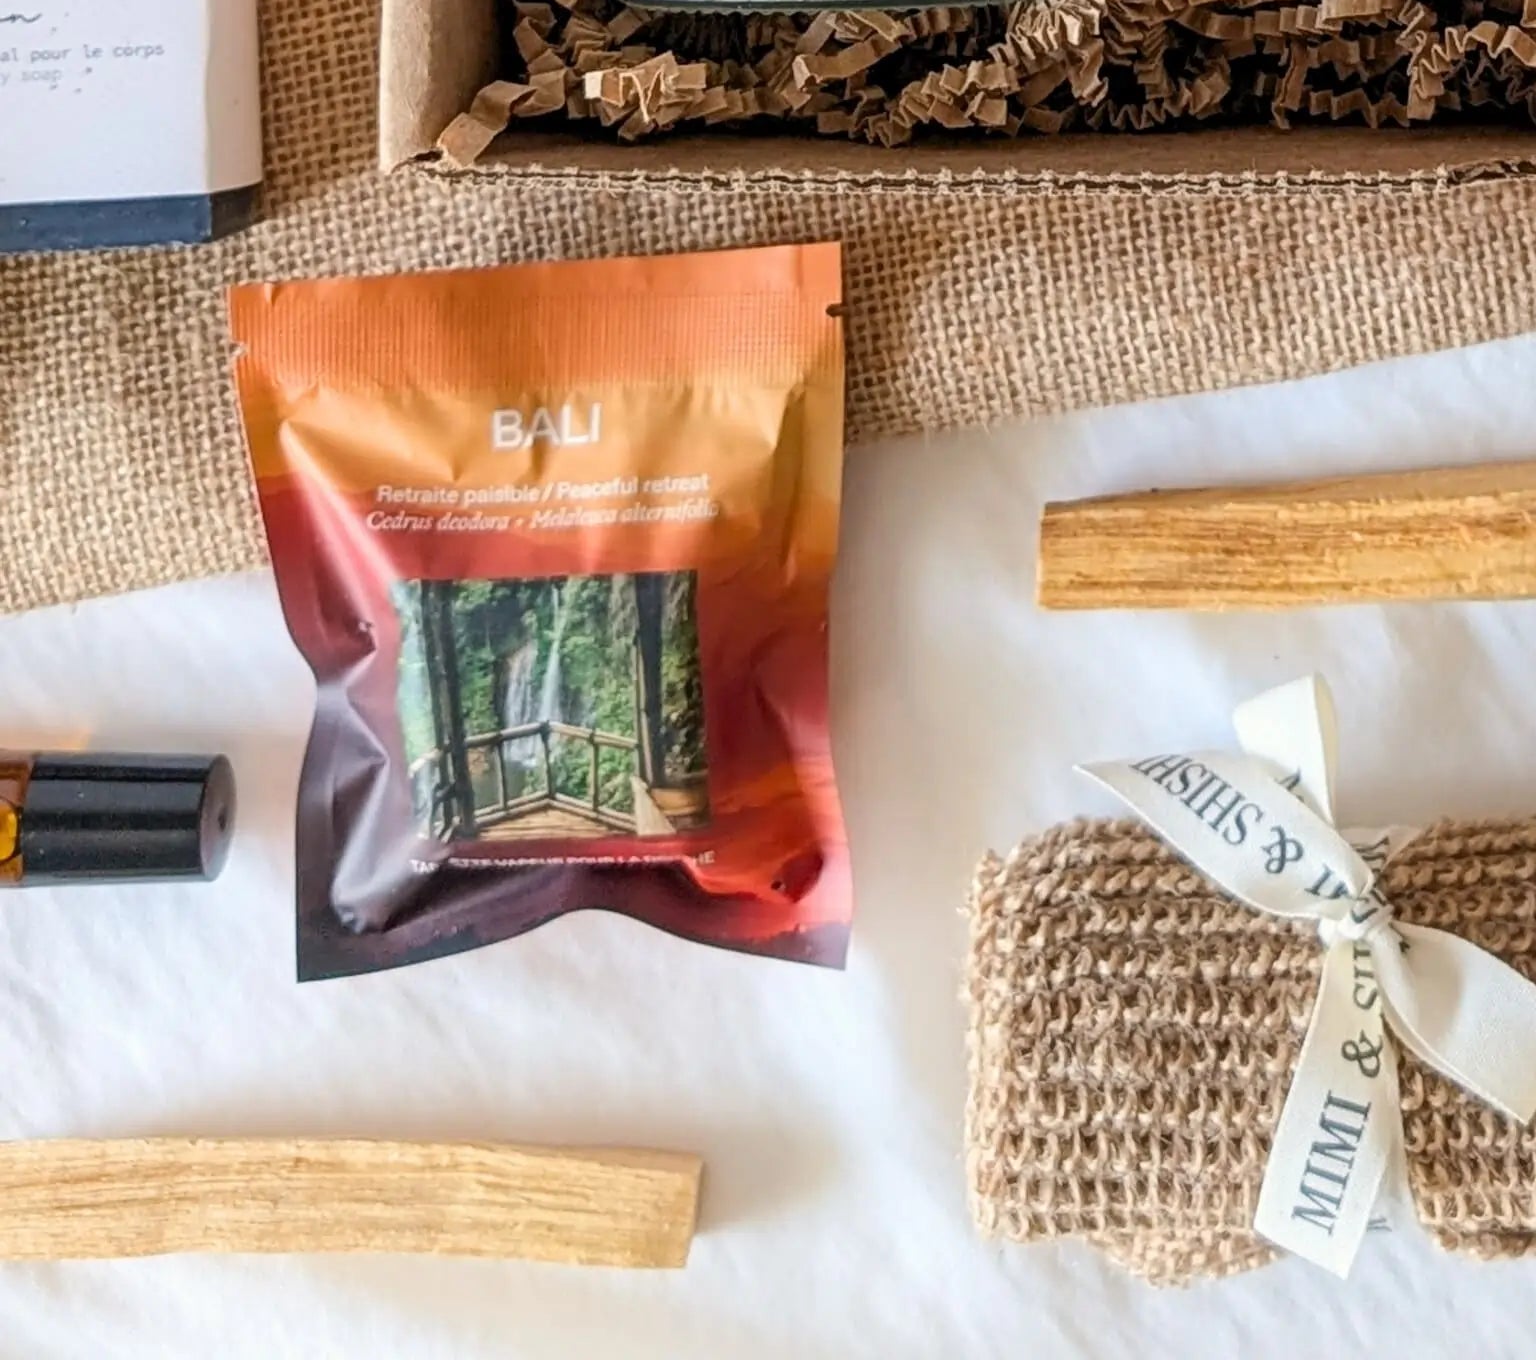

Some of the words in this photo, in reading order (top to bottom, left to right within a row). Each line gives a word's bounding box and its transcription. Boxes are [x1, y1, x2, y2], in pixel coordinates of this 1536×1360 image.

[30, 48, 71, 63] pour
[83, 44, 103, 57] le
[113, 43, 165, 59] corps
[490, 402, 603, 449] BALI
[1130, 754, 1267, 844] SHISHI
[1260, 825, 1303, 874] &
[1290, 1090, 1373, 1236] MIMI
[1342, 1029, 1384, 1078] &
